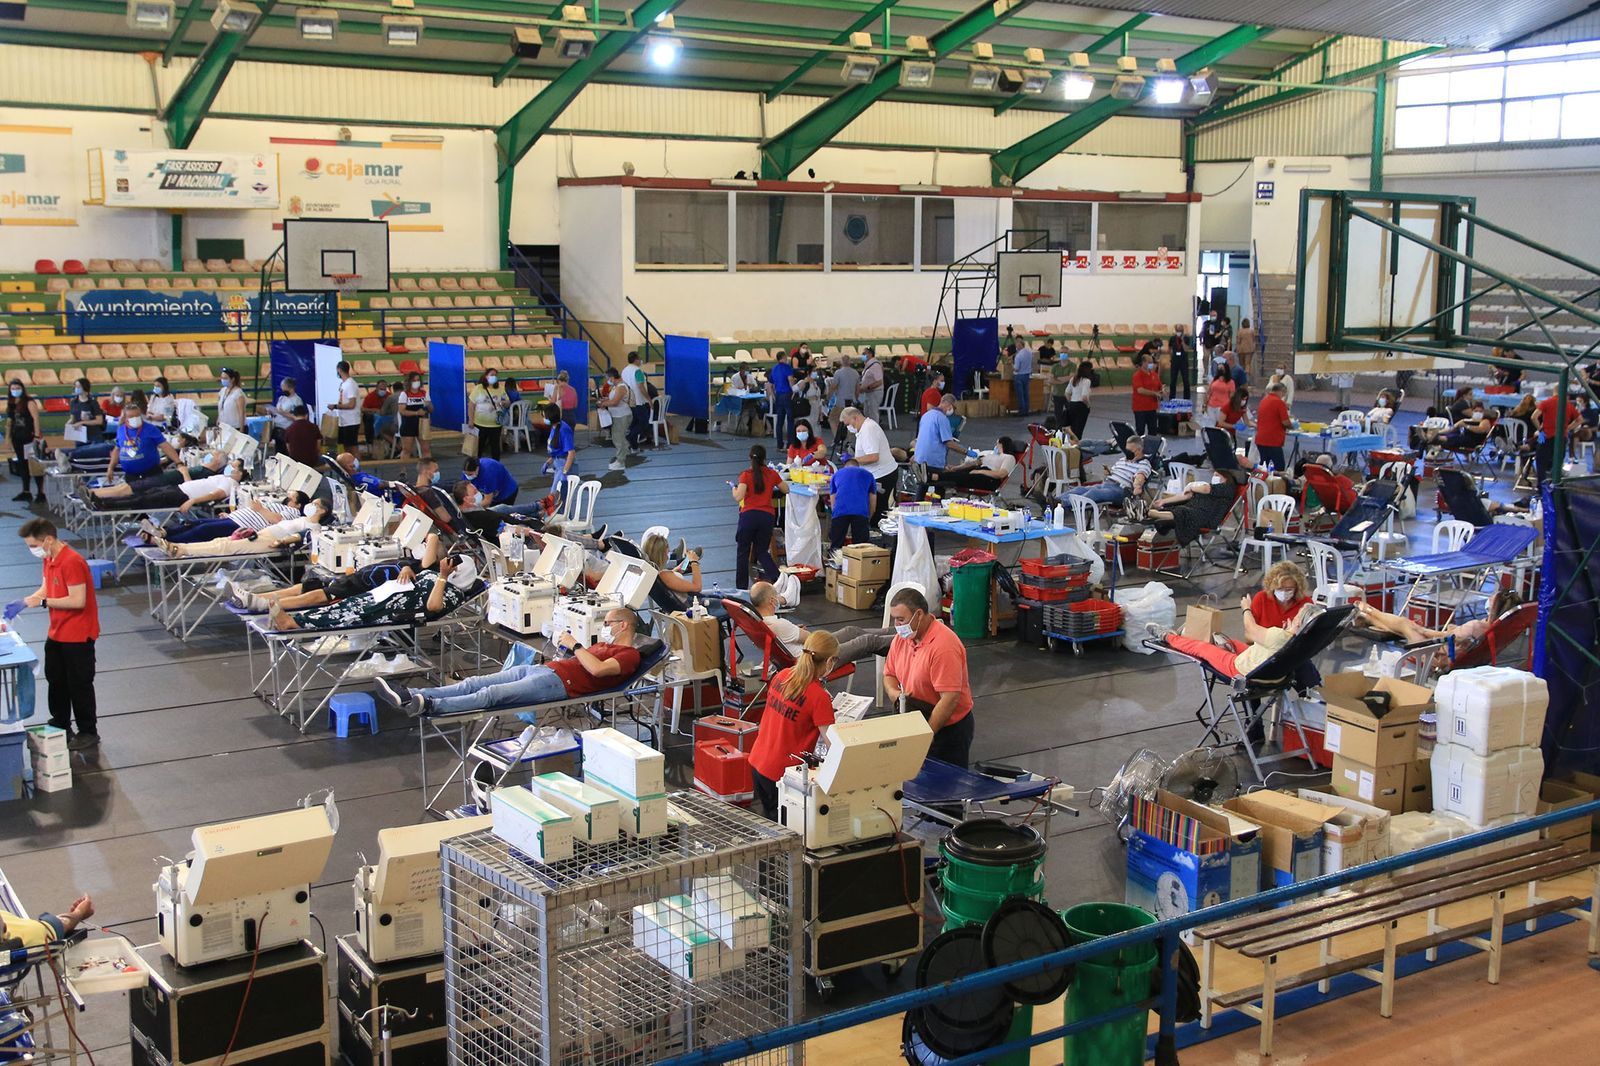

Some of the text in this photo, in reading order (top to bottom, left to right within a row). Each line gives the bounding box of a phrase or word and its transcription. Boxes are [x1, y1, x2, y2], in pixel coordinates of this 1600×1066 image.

[165, 160, 219, 172] FASE ASCENSO
[326, 158, 403, 181] cajamar
[175, 174, 224, 189] NACIONAL
[74, 297, 330, 320] Ayuntamiento Almería
